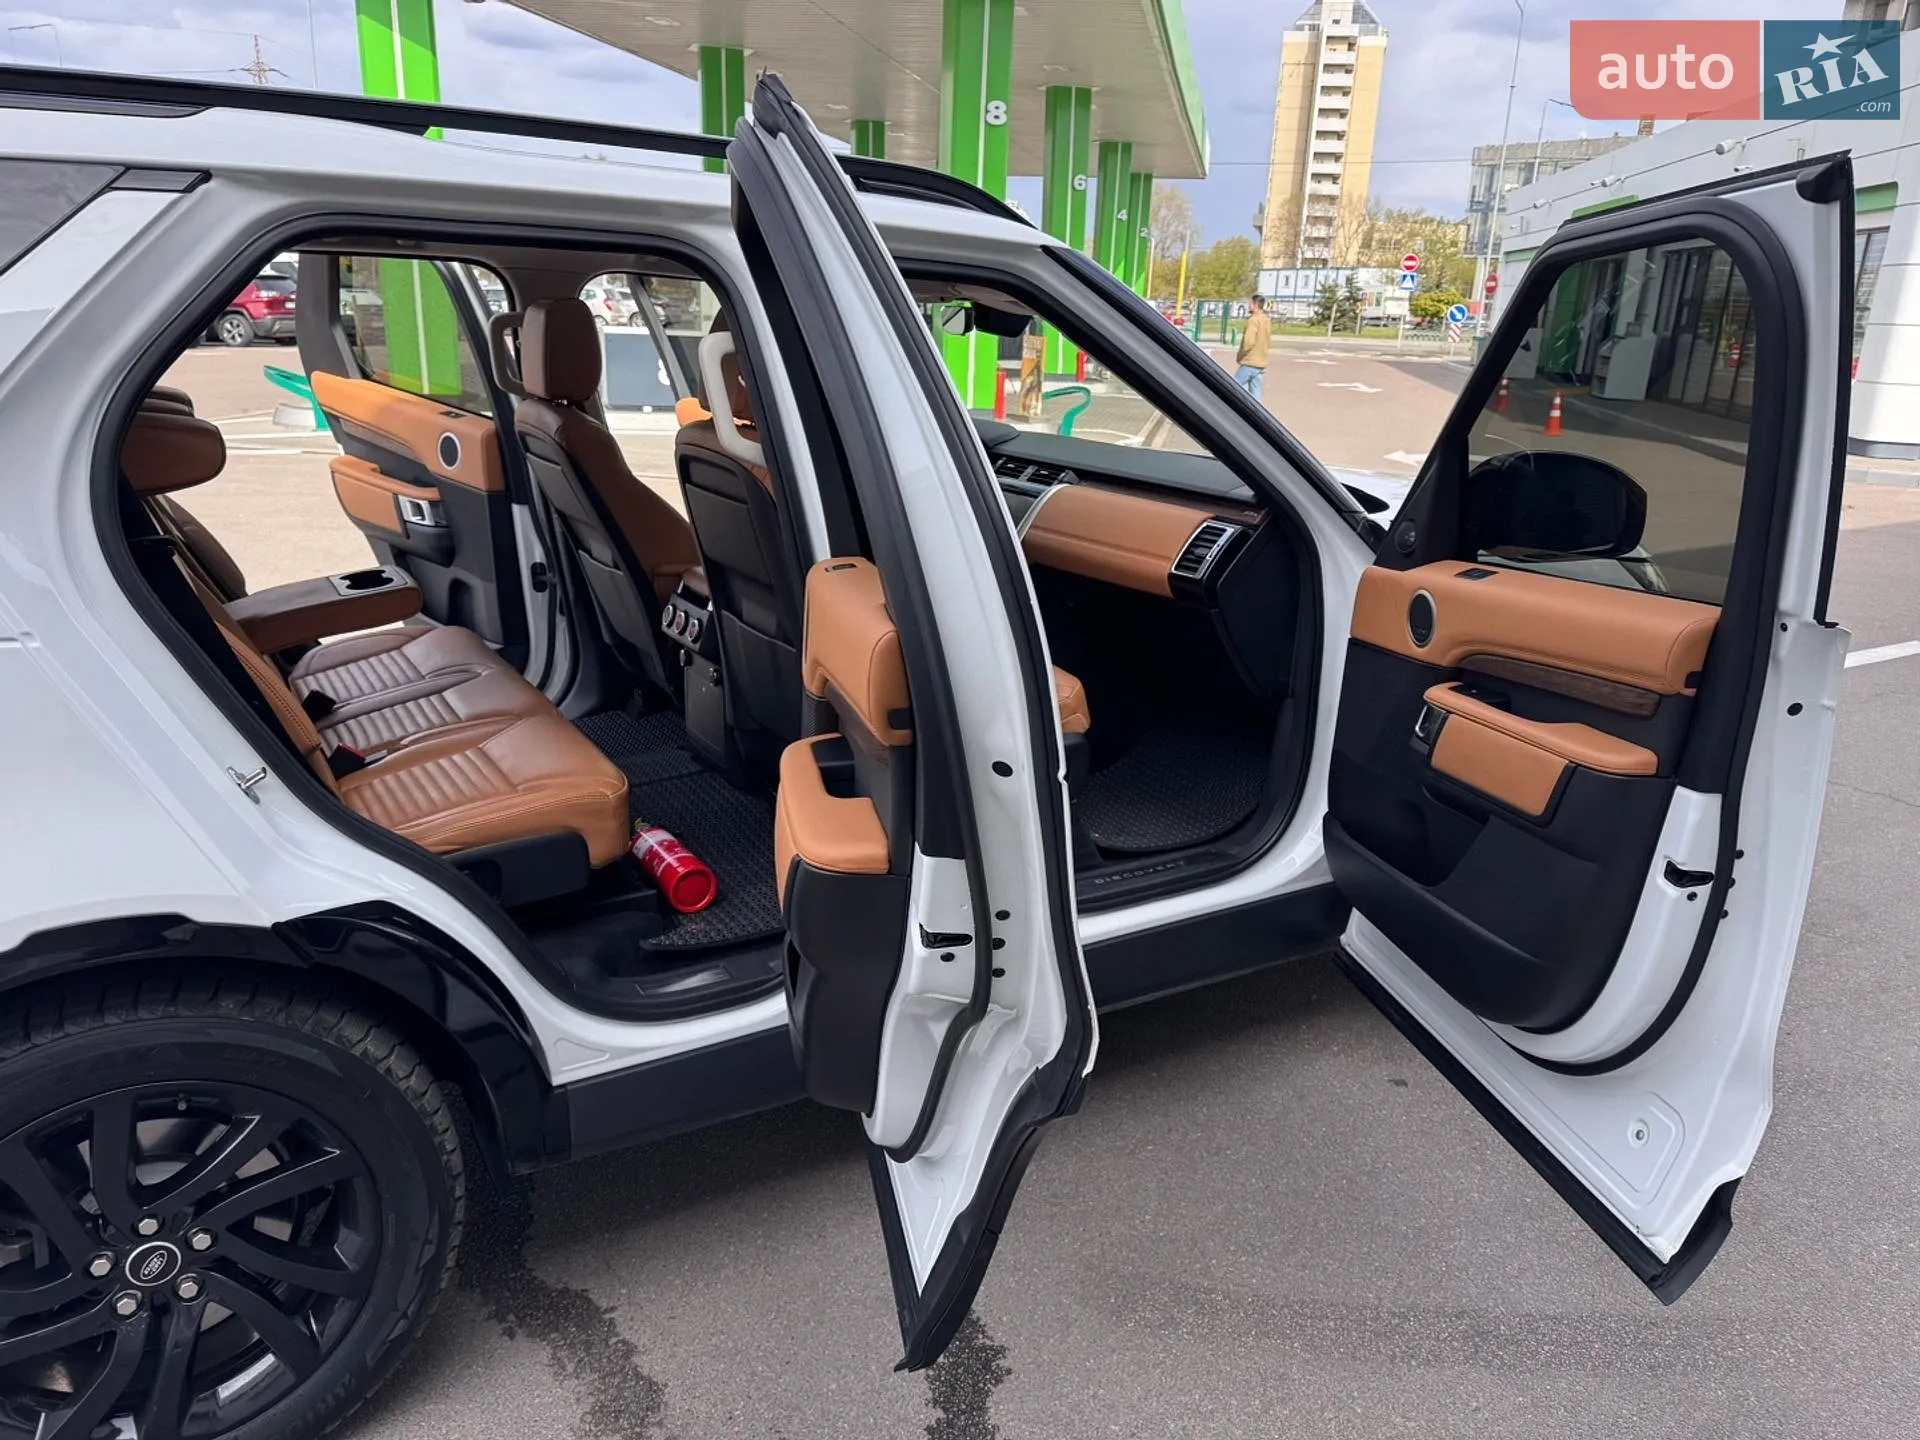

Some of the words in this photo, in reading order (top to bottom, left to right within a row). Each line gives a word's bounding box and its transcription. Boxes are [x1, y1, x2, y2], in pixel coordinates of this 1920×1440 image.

[986, 100, 1008, 126] 8
[1073, 174, 1088, 191] 6
[1117, 210, 1128, 221] 4
